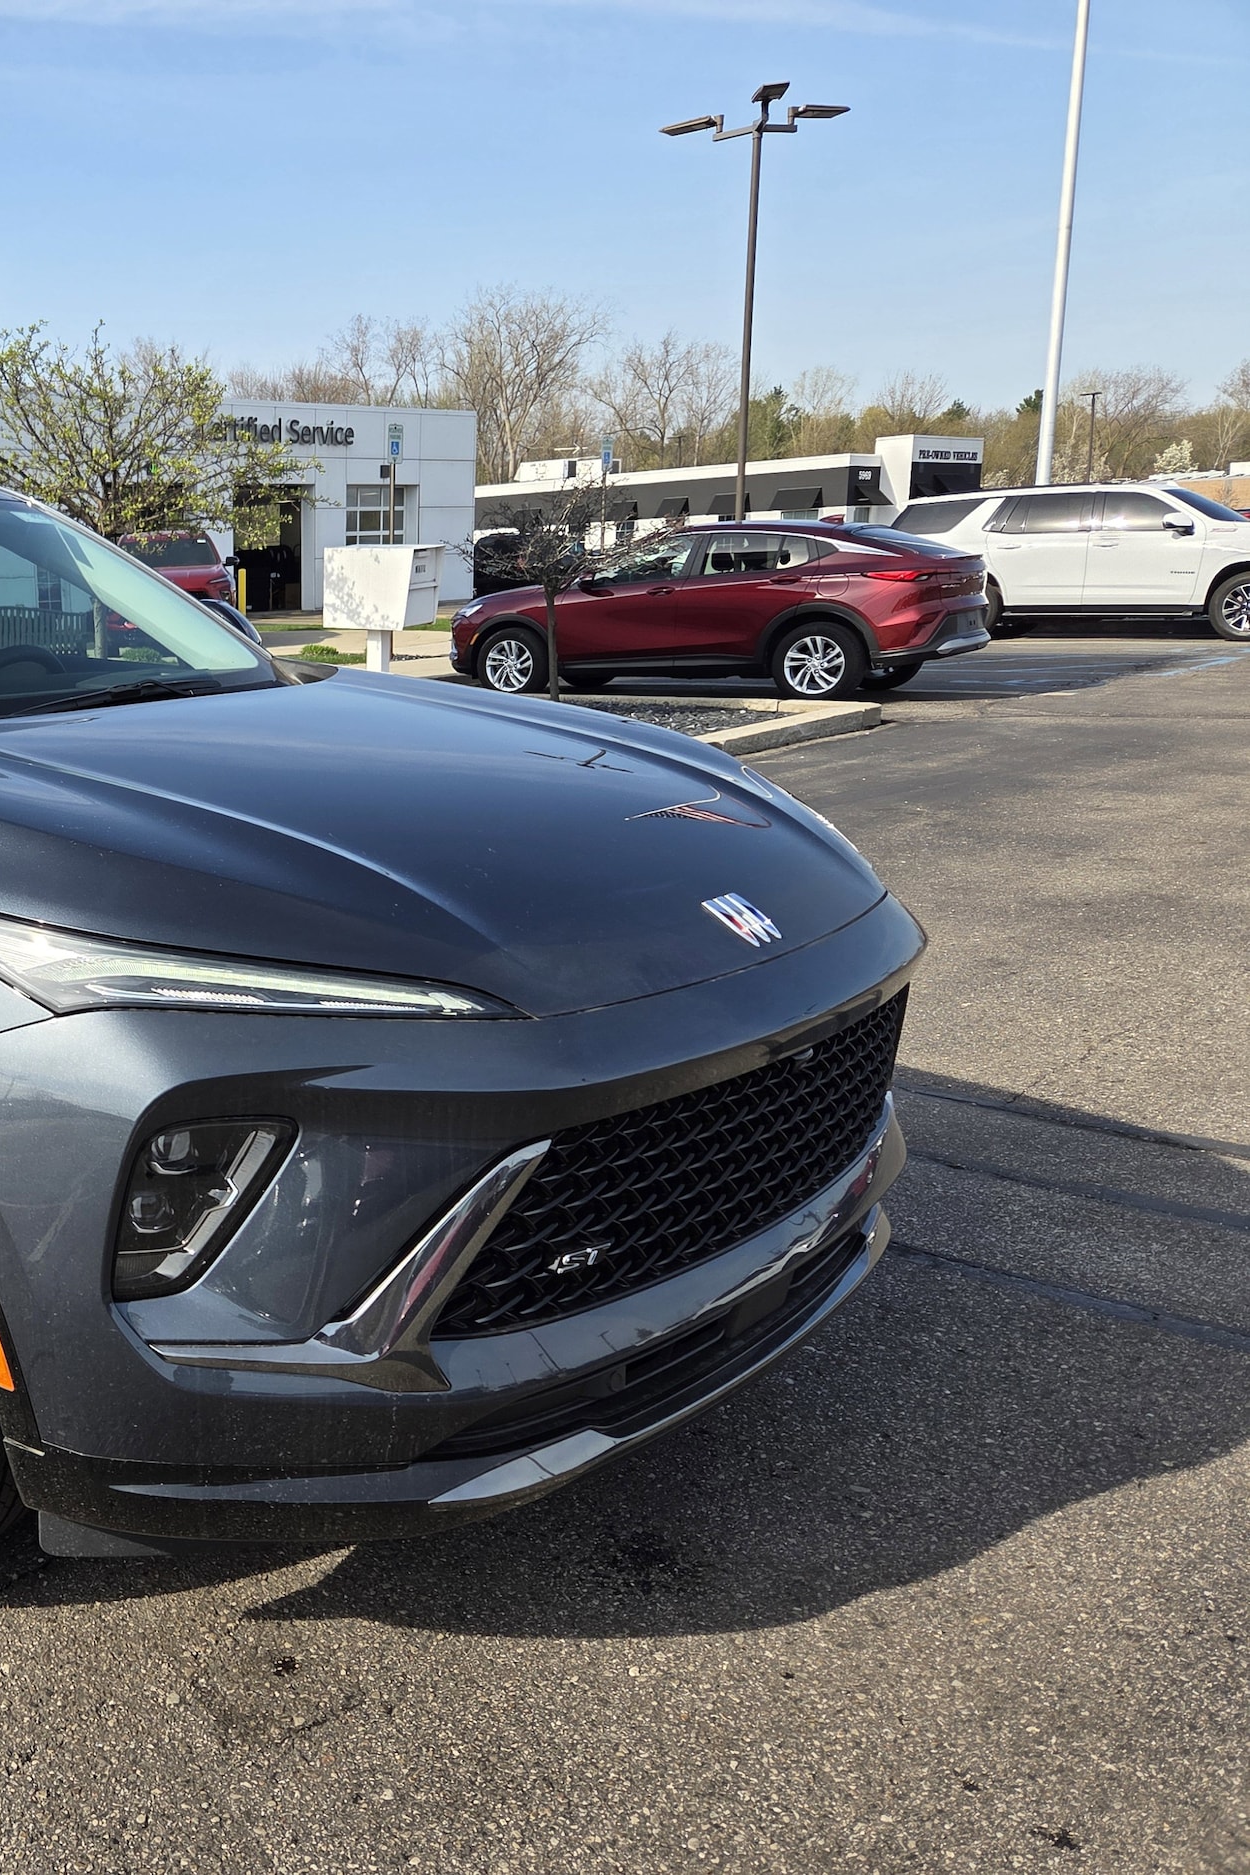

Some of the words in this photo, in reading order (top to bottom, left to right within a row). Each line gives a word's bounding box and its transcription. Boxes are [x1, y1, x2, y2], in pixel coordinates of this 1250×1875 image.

[211, 416, 282, 443] ertified
[287, 419, 355, 446] Service
[918, 449, 951, 460] PRE-OWNED
[952, 451, 978, 462] VEHICLES
